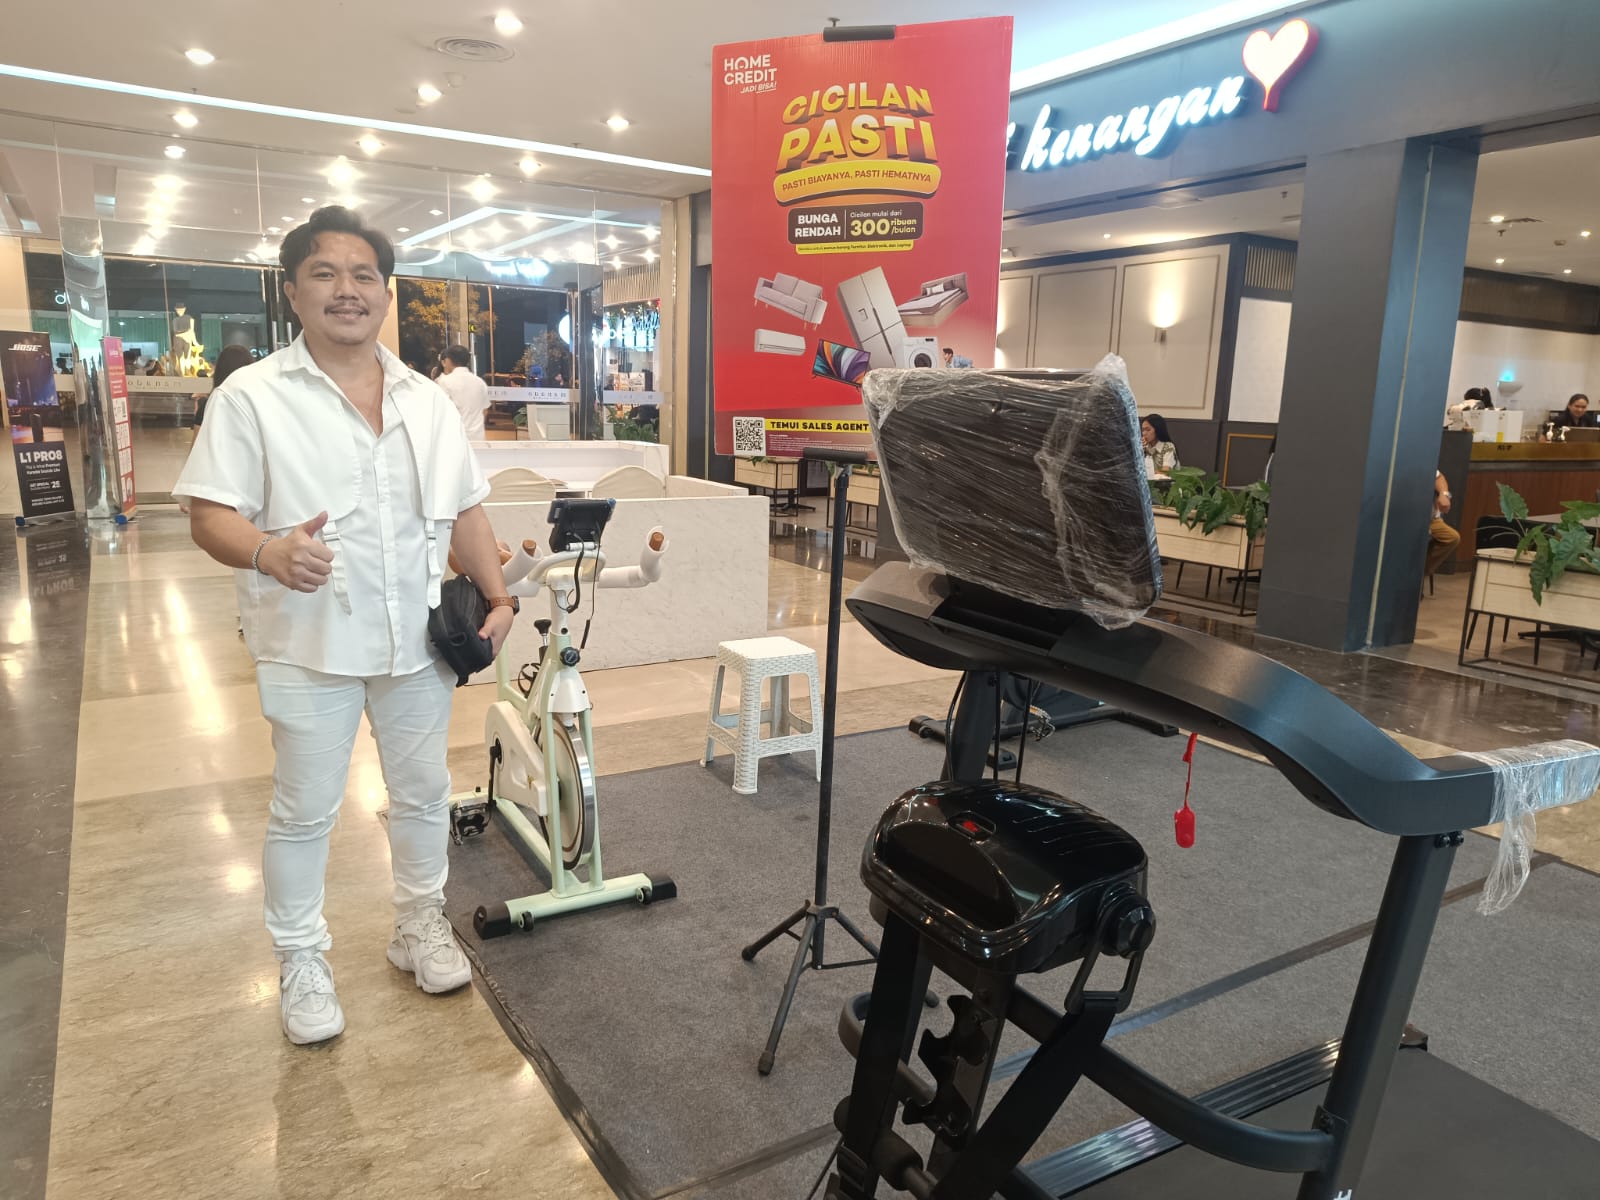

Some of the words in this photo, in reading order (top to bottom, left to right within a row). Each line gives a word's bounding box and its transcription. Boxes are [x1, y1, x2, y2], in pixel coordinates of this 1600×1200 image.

[723, 54, 771, 71] HOME
[723, 68, 777, 85] CREDIT
[740, 85, 757, 93] JADI
[758, 82, 777, 91] BISA!
[782, 82, 934, 124] CICILAN
[1020, 75, 1246, 170] kenangan
[776, 114, 938, 173] PASTI
[782, 179, 806, 191] PASTI
[808, 171, 853, 184] BIAYANYA,
[855, 169, 880, 178] PASTI
[882, 169, 931, 182] HEMATNYA
[797, 213, 838, 225] BUNGA
[850, 218, 890, 236] 300
[891, 218, 917, 226] ribuan
[795, 226, 841, 238] RENDAH
[891, 226, 916, 235] /bulan
[8, 344, 42, 352] BOSE
[770, 421, 799, 429] TEMUI
[802, 422, 832, 430] SALES
[836, 423, 869, 431] AGENT
[19, 452, 32, 464] L1
[33, 449, 63, 462] PRO8
